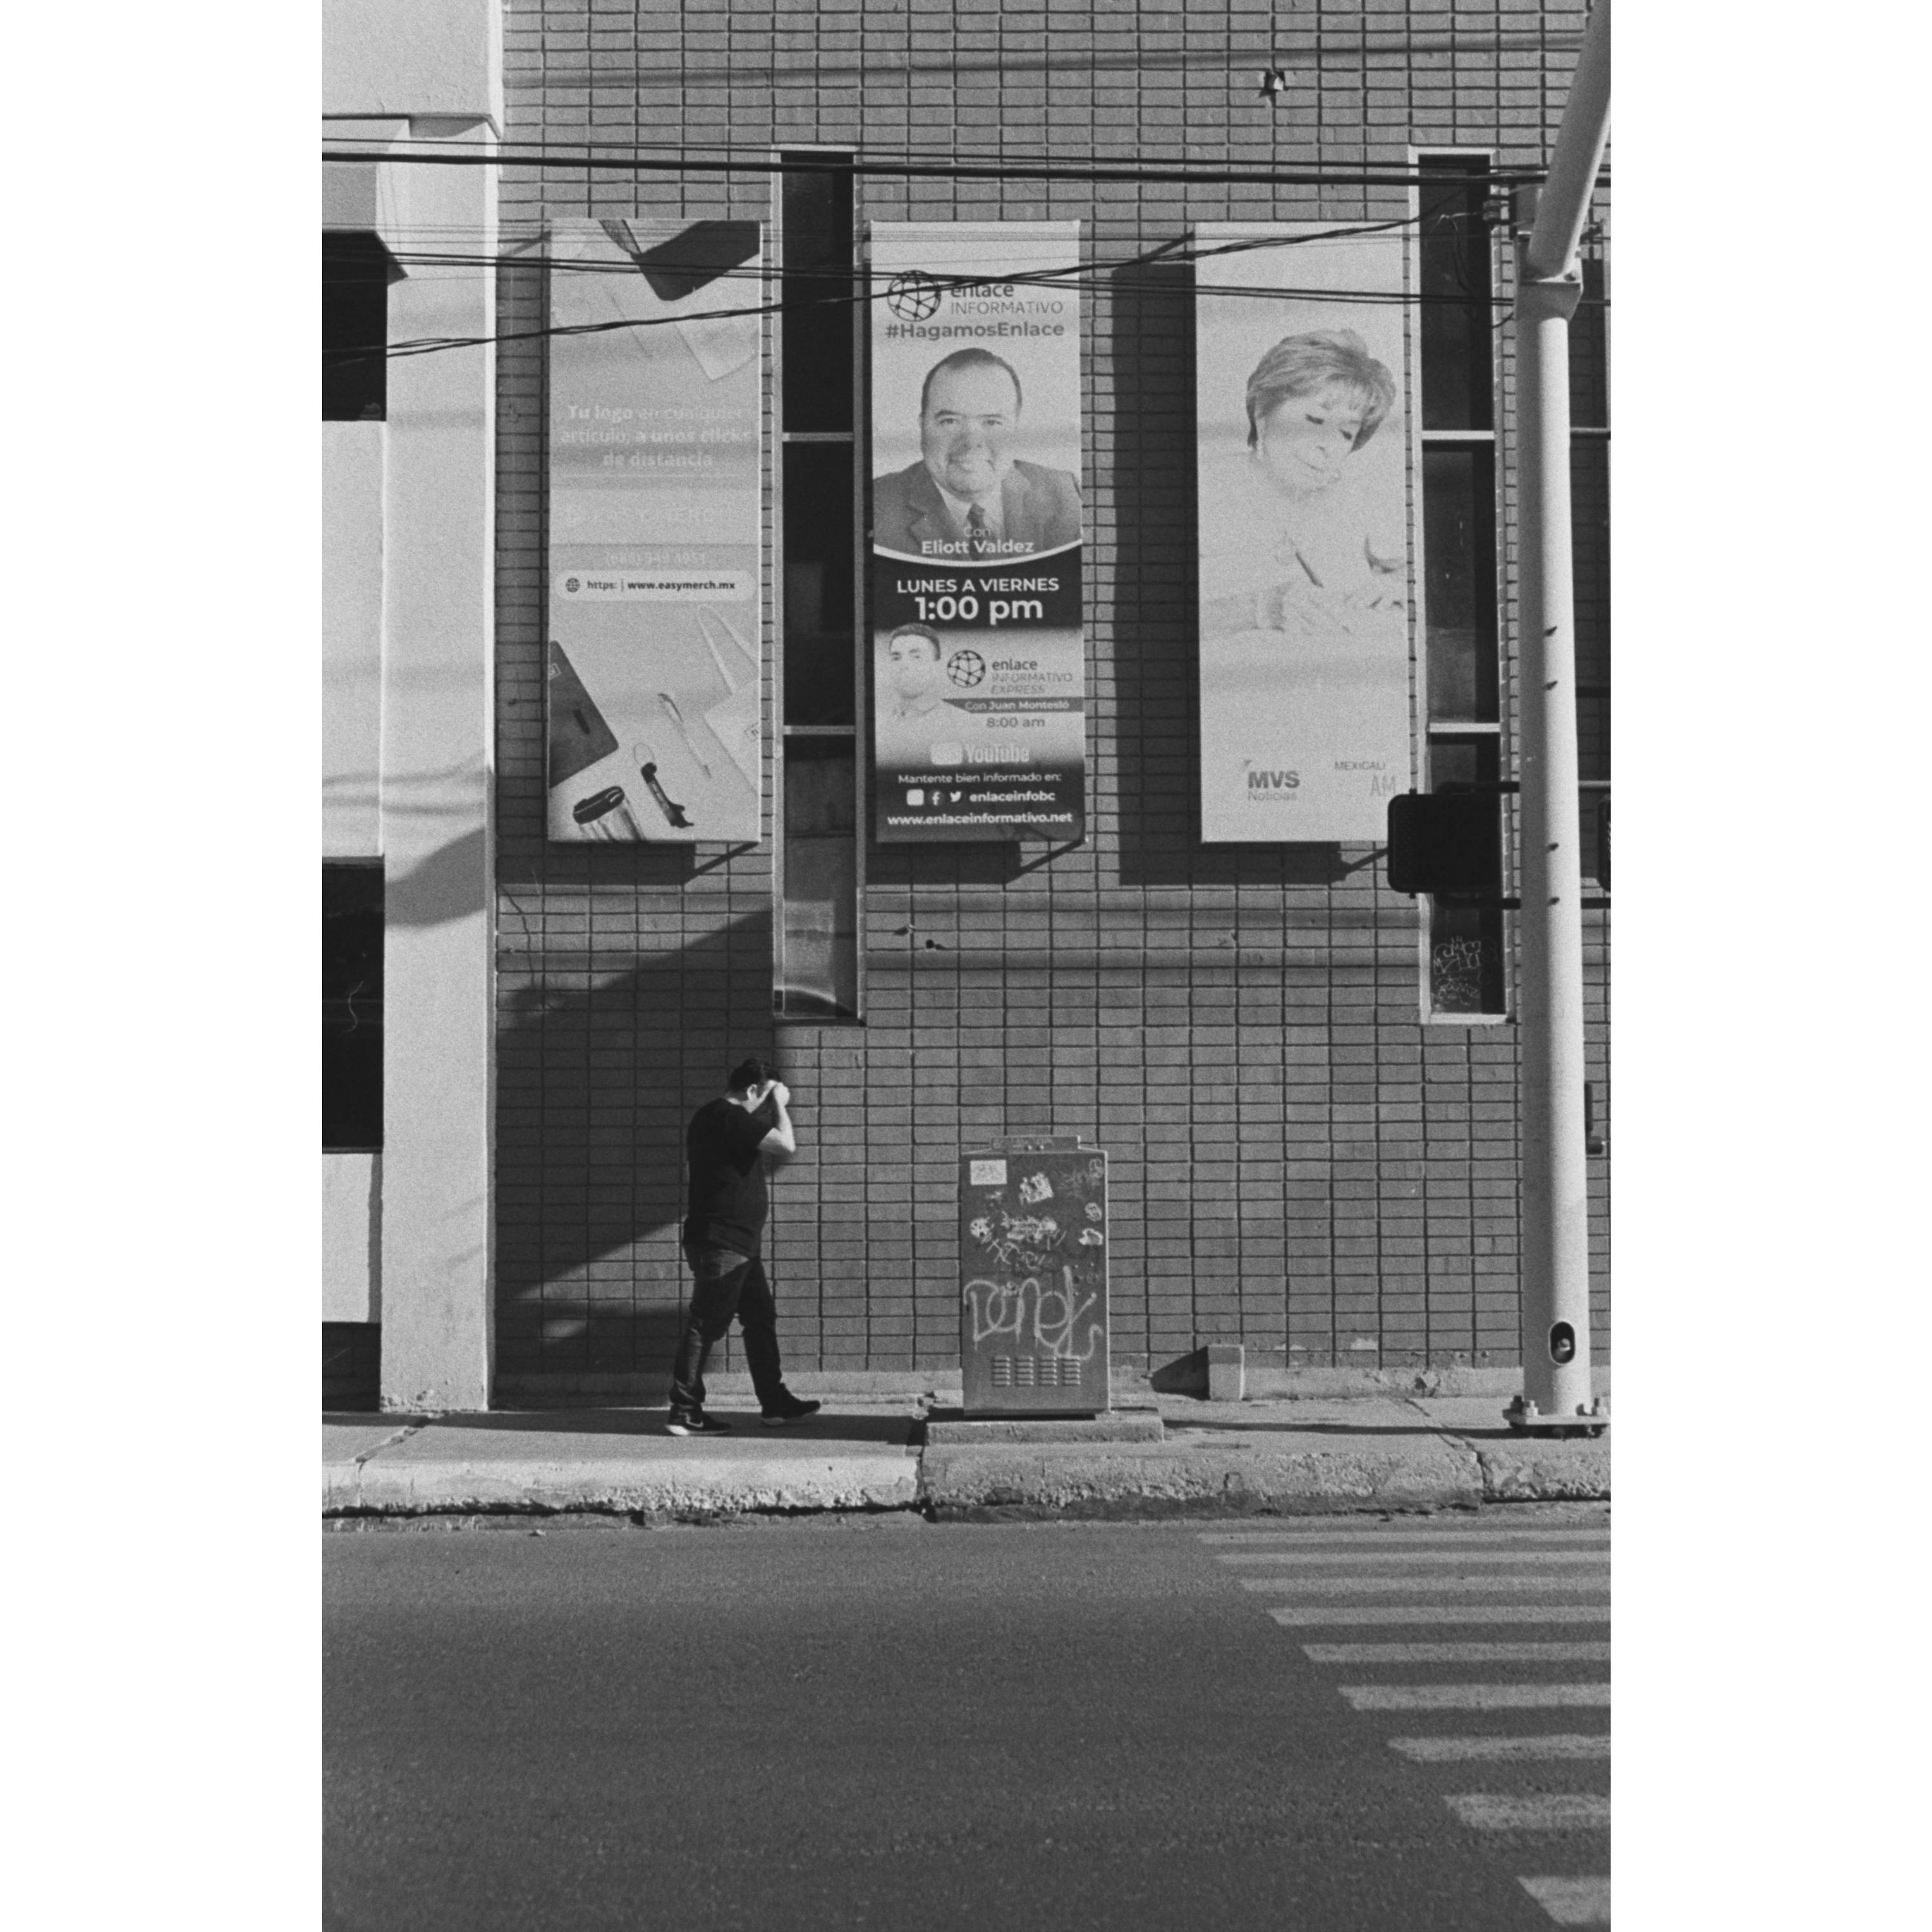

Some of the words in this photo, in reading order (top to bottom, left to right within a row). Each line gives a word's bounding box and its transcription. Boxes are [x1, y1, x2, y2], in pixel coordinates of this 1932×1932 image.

[951, 301, 1064, 315] INFORMATIVO
[886, 321, 1065, 341] #HagamosEnlace
[594, 405, 634, 424] logo
[650, 431, 696, 444] unos
[603, 452, 625, 467] de
[630, 451, 714, 468] distancia
[963, 526, 992, 538] Con
[922, 539, 969, 555] Eliott
[973, 539, 1034, 554] Valdez
[587, 580, 617, 592] https:
[627, 580, 735, 592] www.easymerch.mx
[897, 578, 958, 594] LUNES
[961, 578, 976, 592] A
[979, 577, 1060, 592] VIERNES
[914, 596, 979, 621] 1:00
[989, 597, 1043, 625] pm
[991, 657, 1038, 672] enlace
[991, 672, 1073, 683] INFORMATIVO
[990, 684, 1046, 696] EXPRESS
[965, 700, 987, 710] Con
[989, 700, 1016, 711] Juan
[986, 717, 1018, 728] 8:00
[1023, 718, 1046, 728] am
[966, 743, 1030, 764] YouTube
[1334, 761, 1387, 771] MEXICALI
[898, 773, 953, 784] Mantente
[955, 773, 981, 783] bien
[983, 772, 1041, 783] informado
[1044, 773, 1063, 782] en:
[1247, 770, 1301, 789] MVS
[969, 791, 1056, 802] enlaceinfobc
[1247, 790, 1298, 801] Noticias
[887, 812, 1073, 826] www.enlaceinformativo.net
